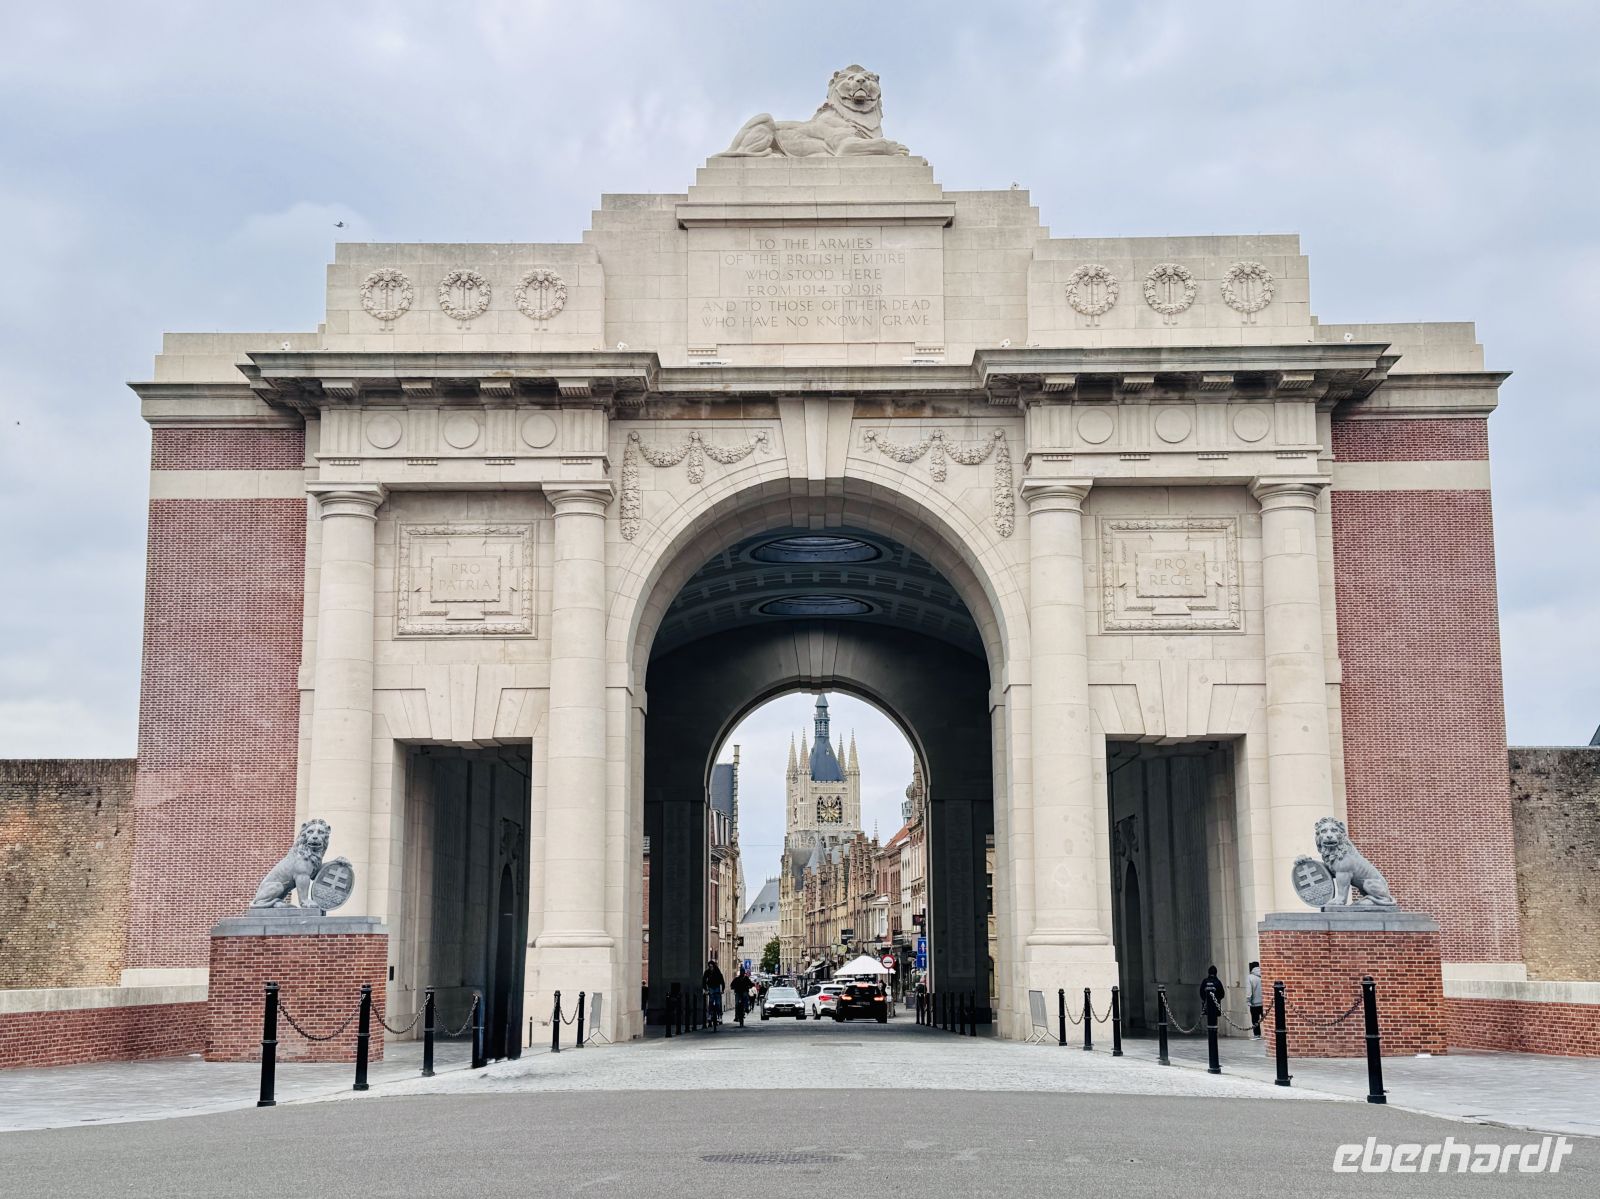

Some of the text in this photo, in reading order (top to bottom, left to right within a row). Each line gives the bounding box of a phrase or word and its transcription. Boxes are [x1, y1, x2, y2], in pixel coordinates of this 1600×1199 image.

[757, 238, 873, 249] TO THE ARMIES
[725, 254, 904, 265] OF THE BRITISH EMPIRE
[745, 269, 881, 280] WHO STOOD HERE
[748, 285, 883, 296] FROM 1914 TO 1918
[703, 300, 930, 312] AND TO THOSE OF THEIR DEAD
[703, 315, 929, 328] WHO HAVE NO KNOWN GRAVE
[450, 563, 480, 575] PRO
[1156, 559, 1186, 569] PRO
[439, 579, 491, 591] PATRIA
[1150, 575, 1192, 586] REGE
